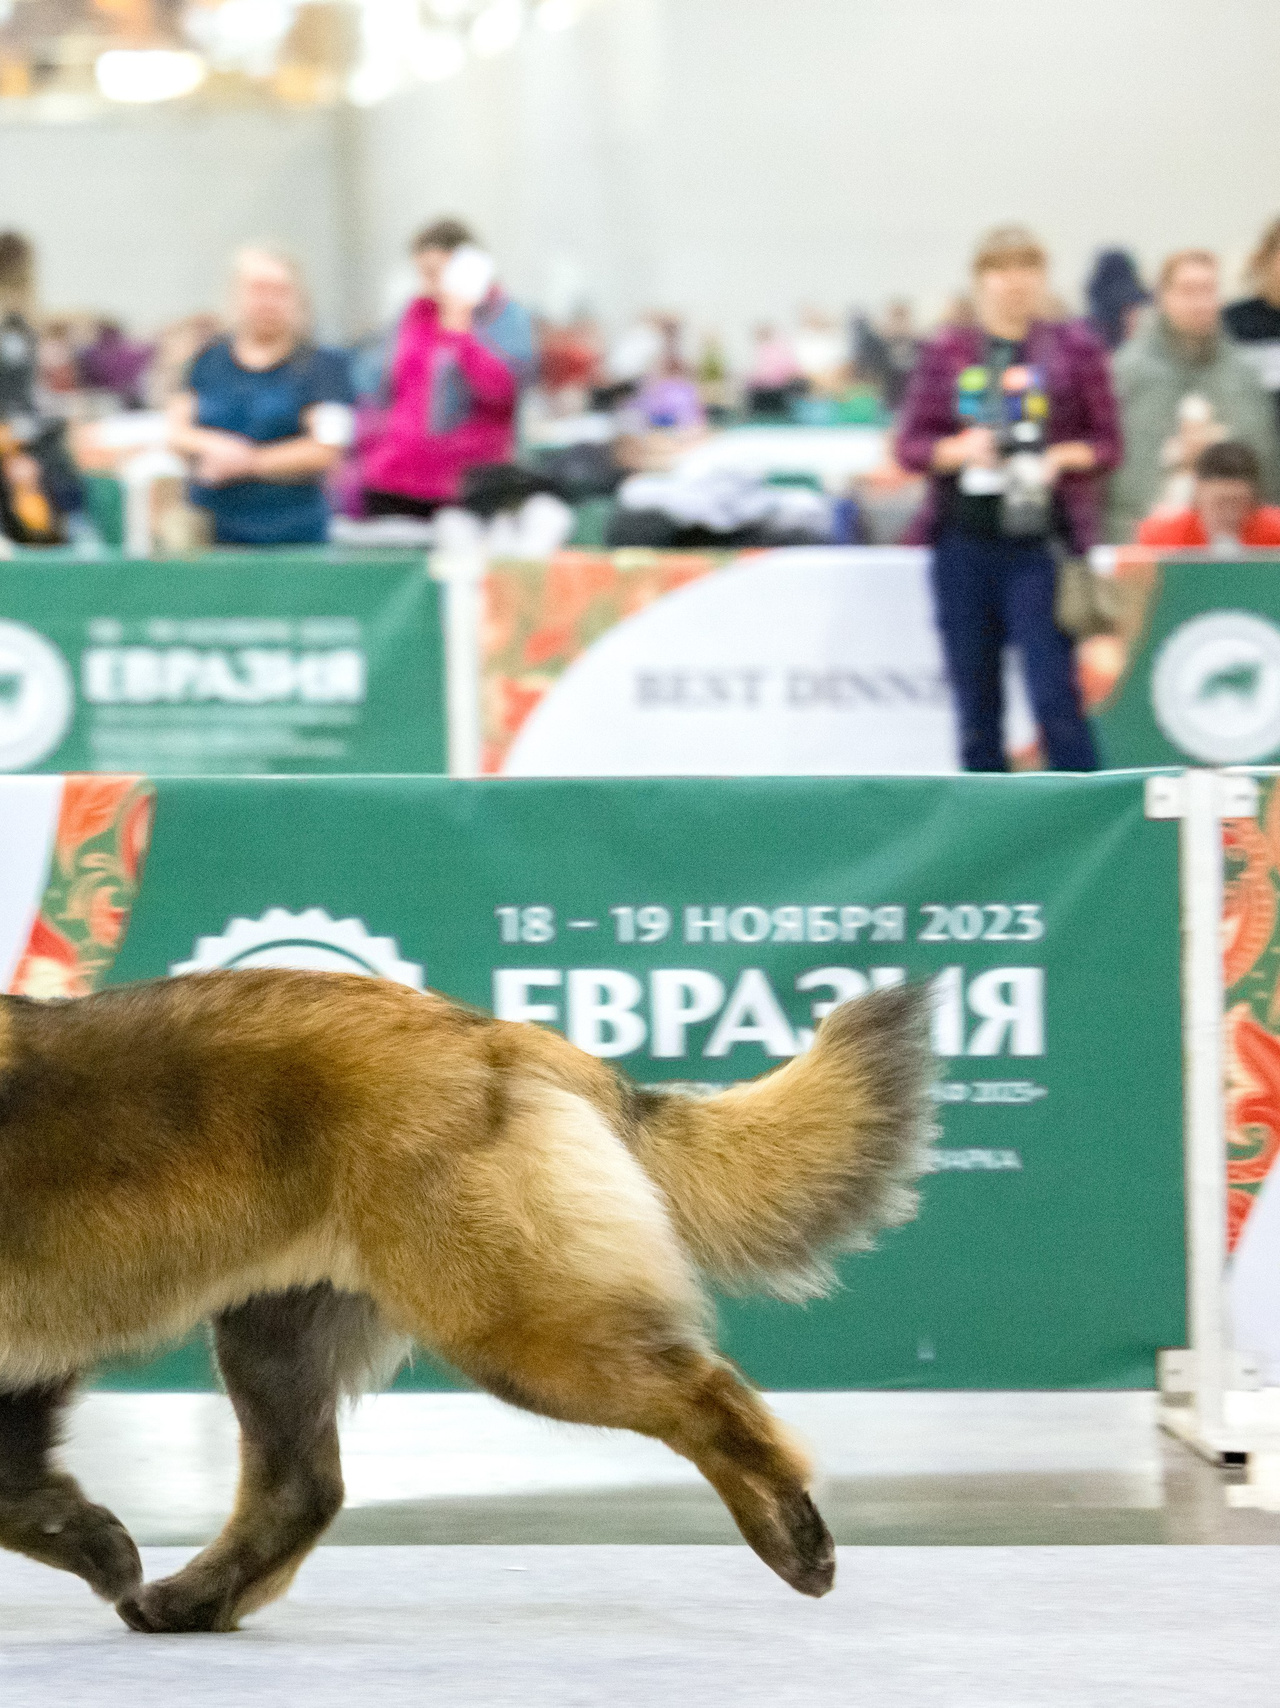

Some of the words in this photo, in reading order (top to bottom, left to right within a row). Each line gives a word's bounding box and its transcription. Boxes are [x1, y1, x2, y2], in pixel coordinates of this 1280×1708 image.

[634, 667, 765, 710] BEST
[495, 905, 556, 943] 18
[610, 904, 672, 943] 19
[683, 904, 905, 944] НОЯБРЯ
[918, 903, 1045, 942] 2023
